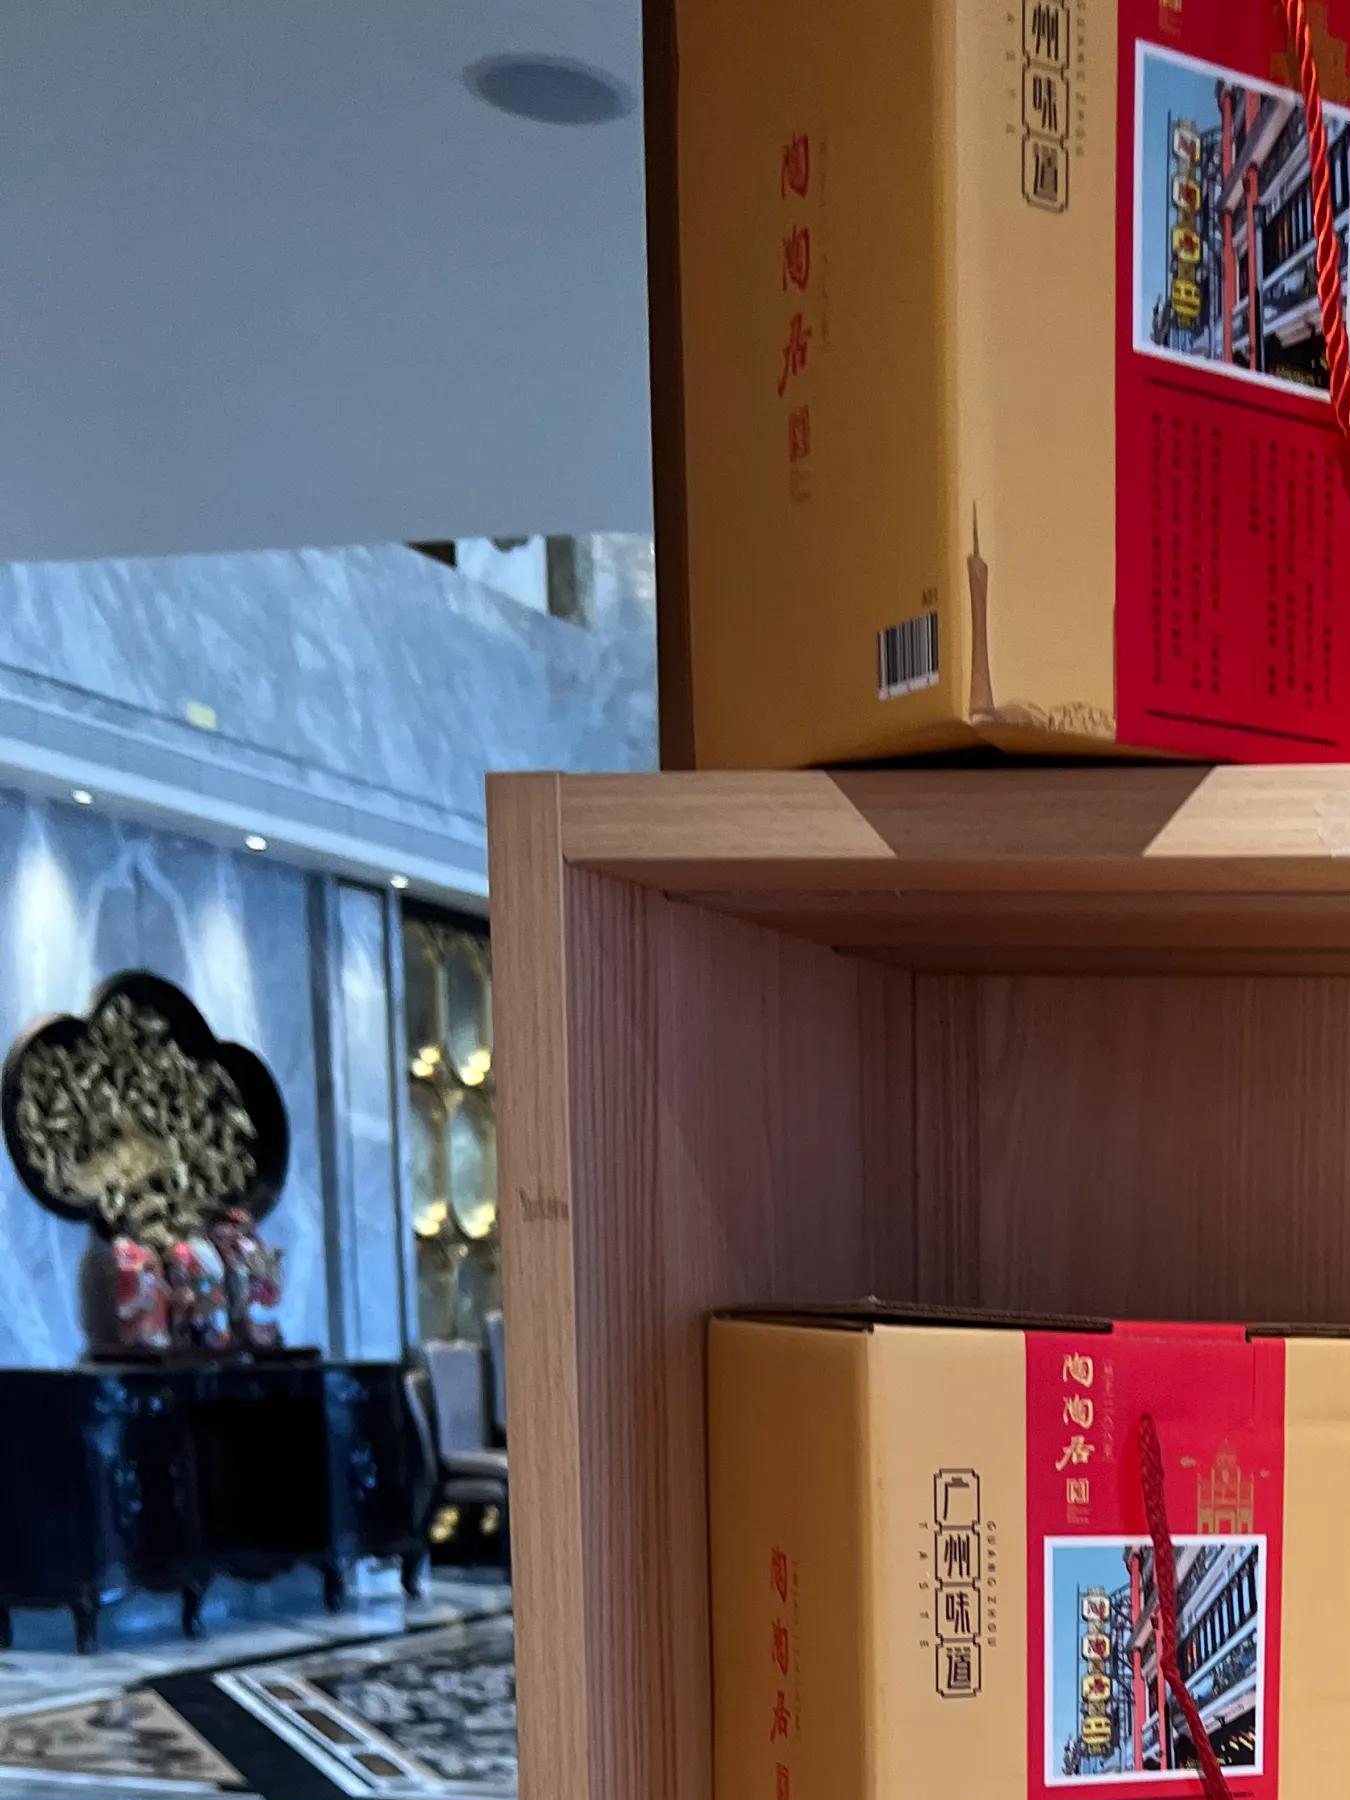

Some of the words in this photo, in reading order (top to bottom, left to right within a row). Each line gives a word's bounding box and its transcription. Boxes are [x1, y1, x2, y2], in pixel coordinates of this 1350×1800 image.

[1055, 1352, 1095, 1472] 陶陶居
[942, 1475, 972, 1690] 广州味道
